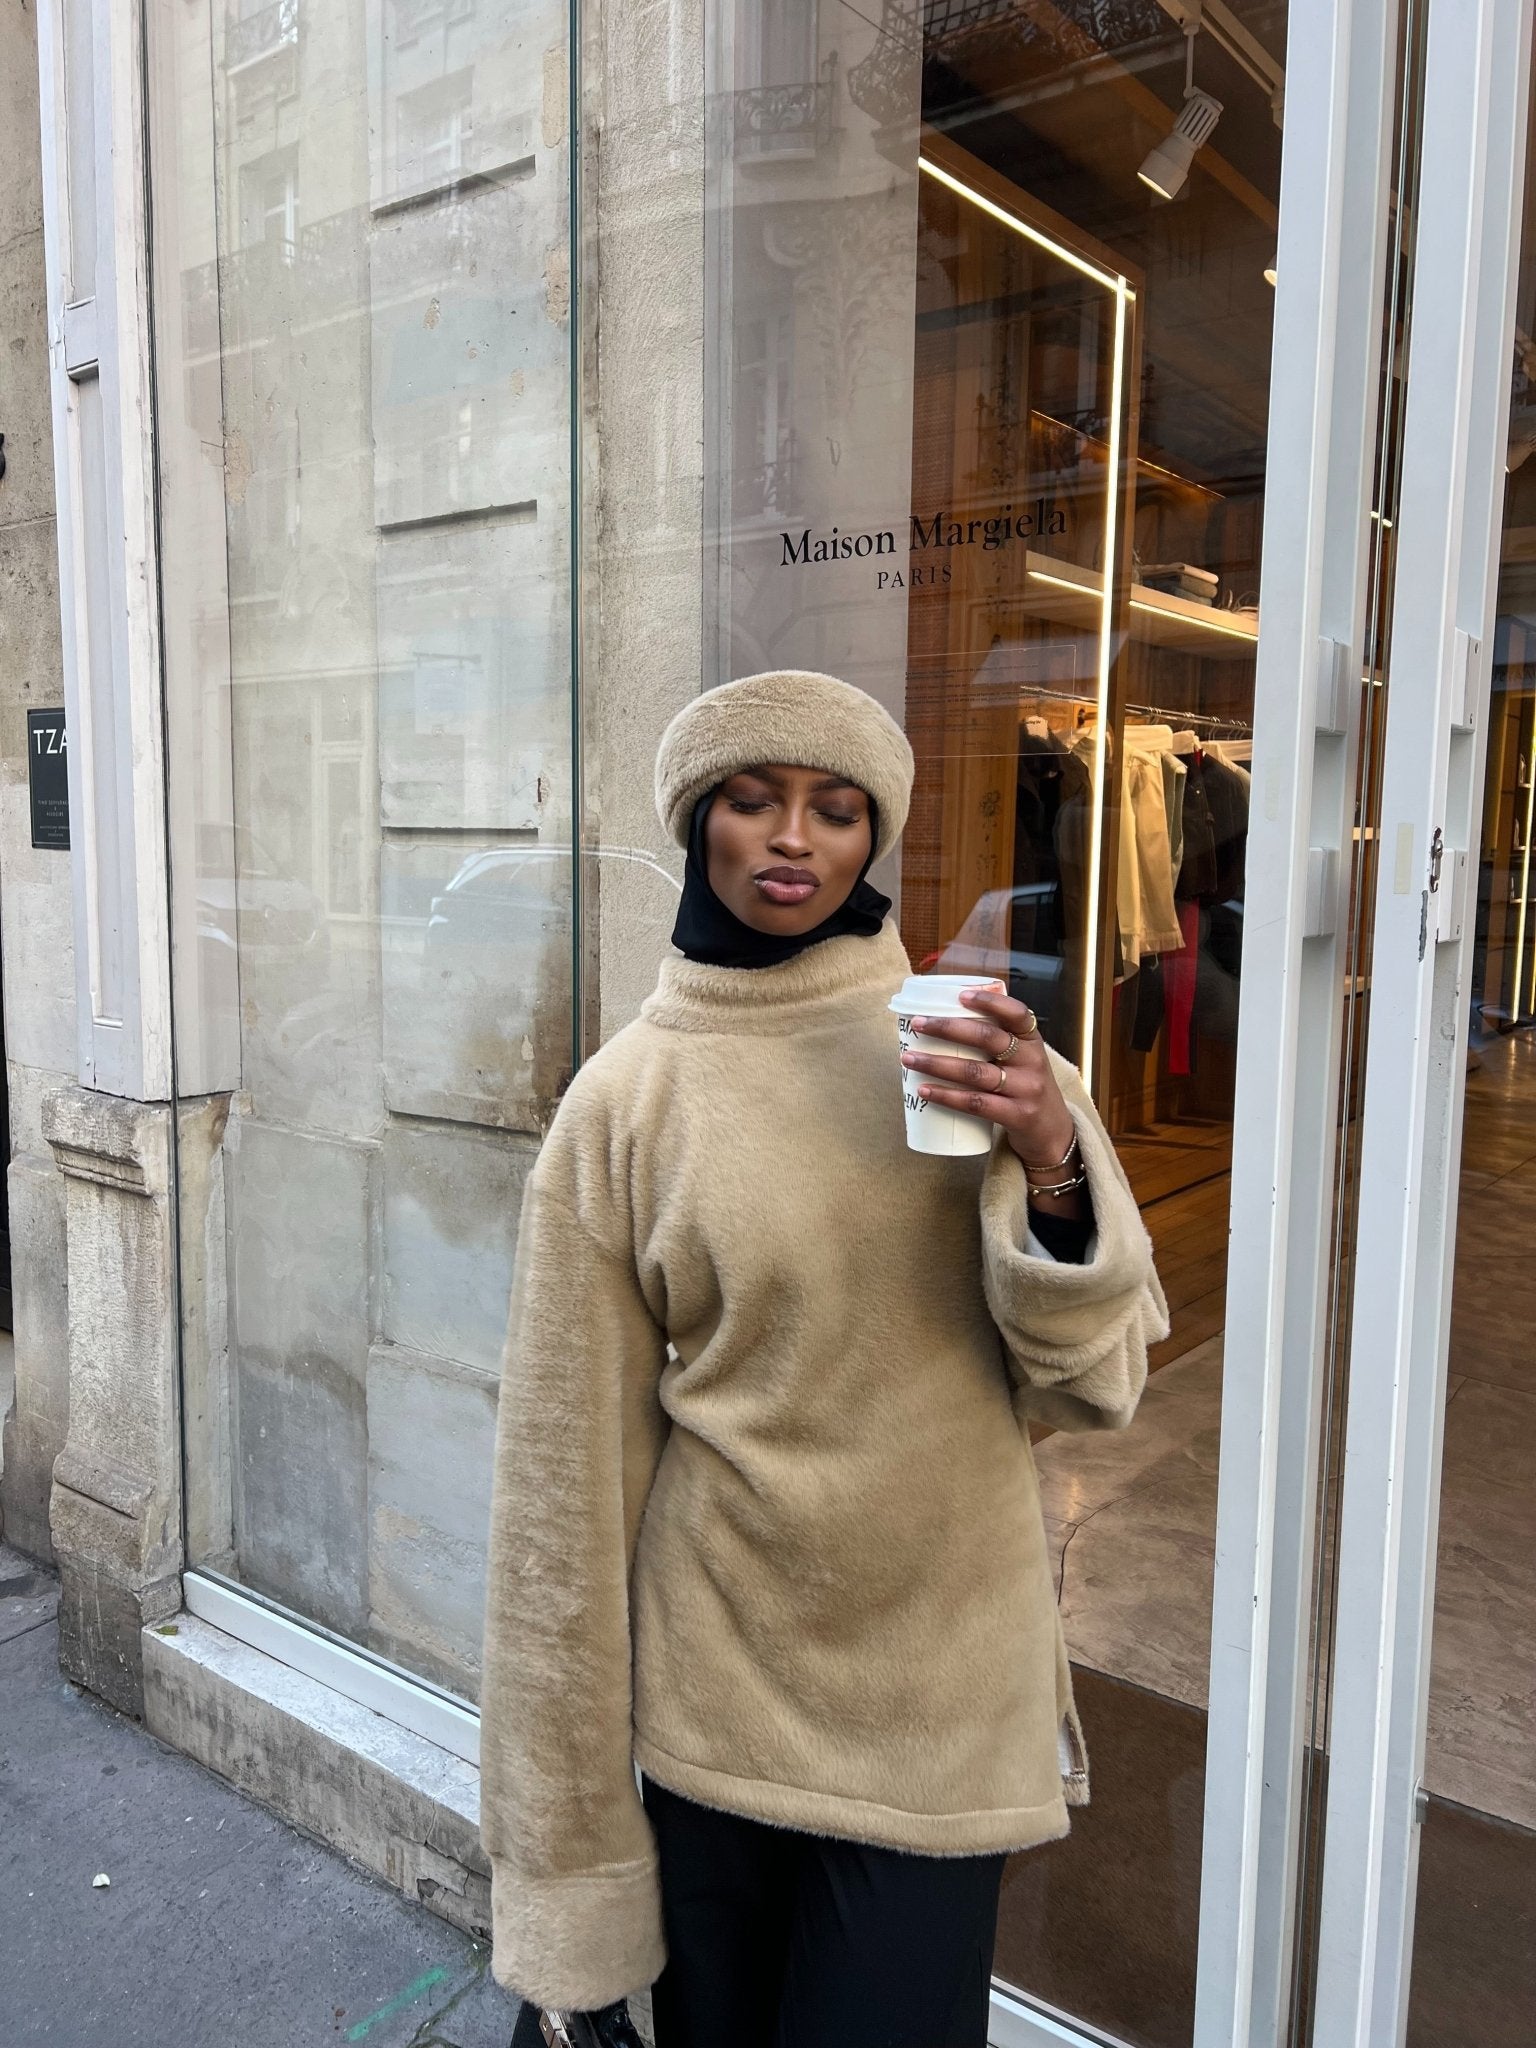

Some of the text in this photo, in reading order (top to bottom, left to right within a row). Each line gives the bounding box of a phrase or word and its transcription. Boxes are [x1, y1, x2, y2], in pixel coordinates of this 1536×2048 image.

[780, 497, 1067, 566] Maison Margiela
[876, 564, 952, 589] PARIS
